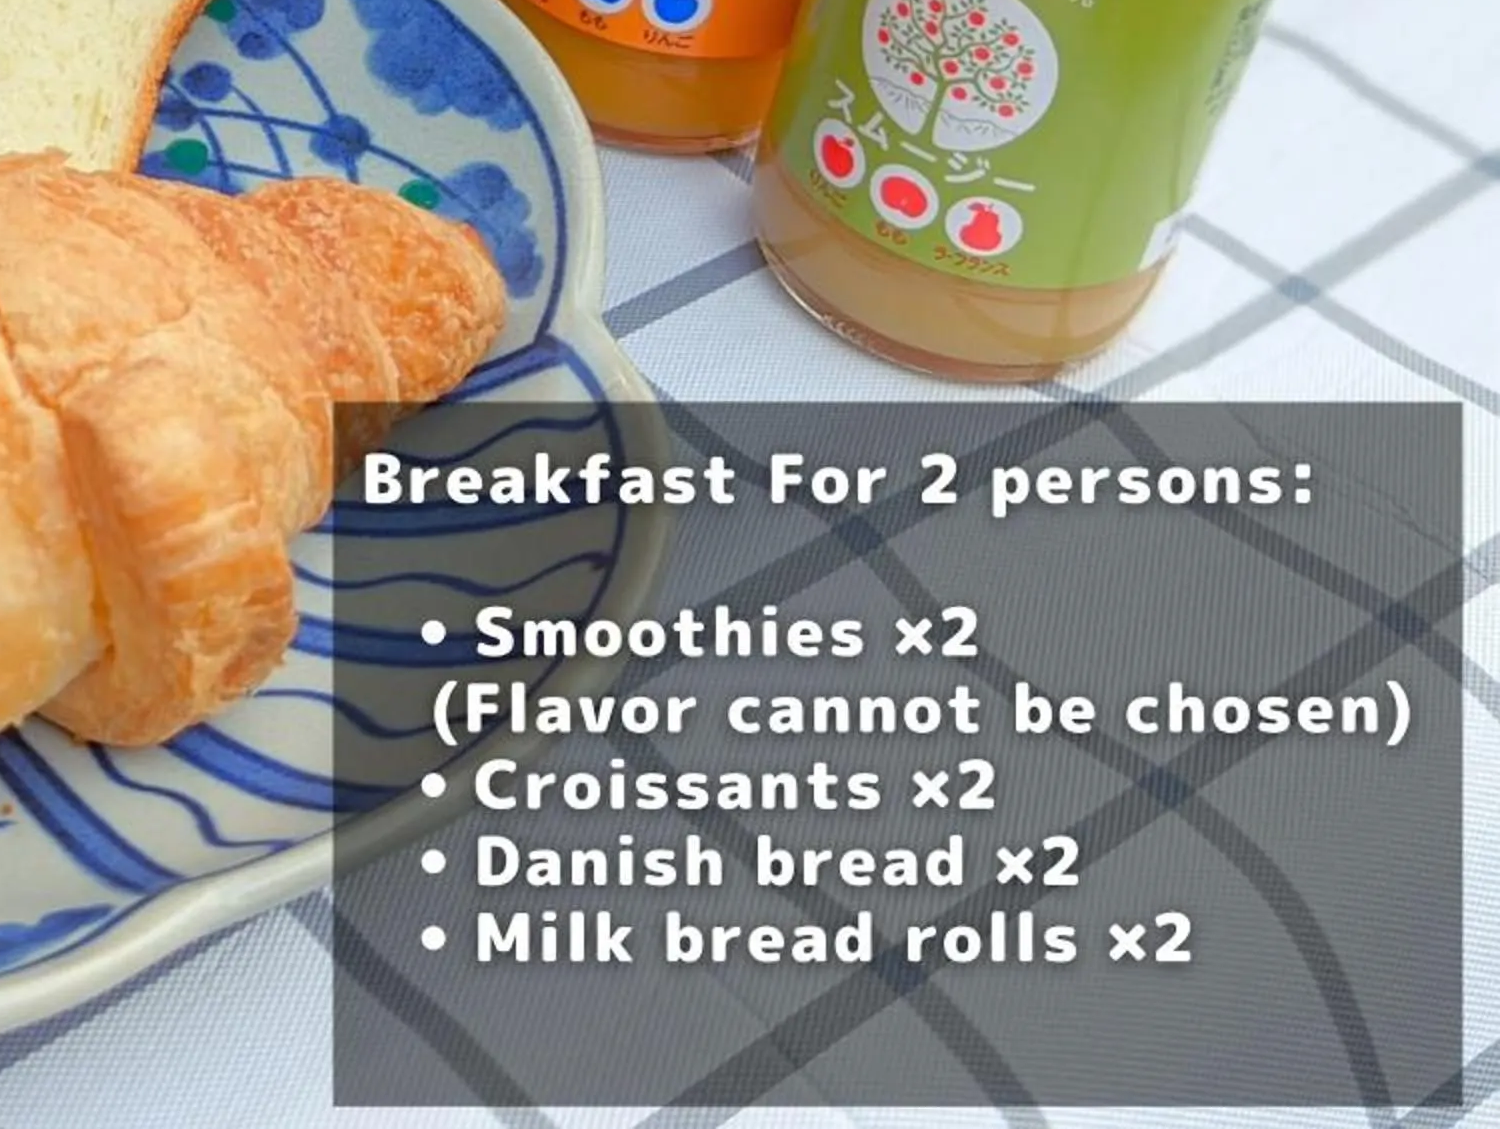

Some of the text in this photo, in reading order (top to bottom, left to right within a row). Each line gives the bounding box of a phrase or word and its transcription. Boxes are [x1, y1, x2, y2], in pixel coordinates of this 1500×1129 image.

[827, 79, 1036, 192] スムージー
